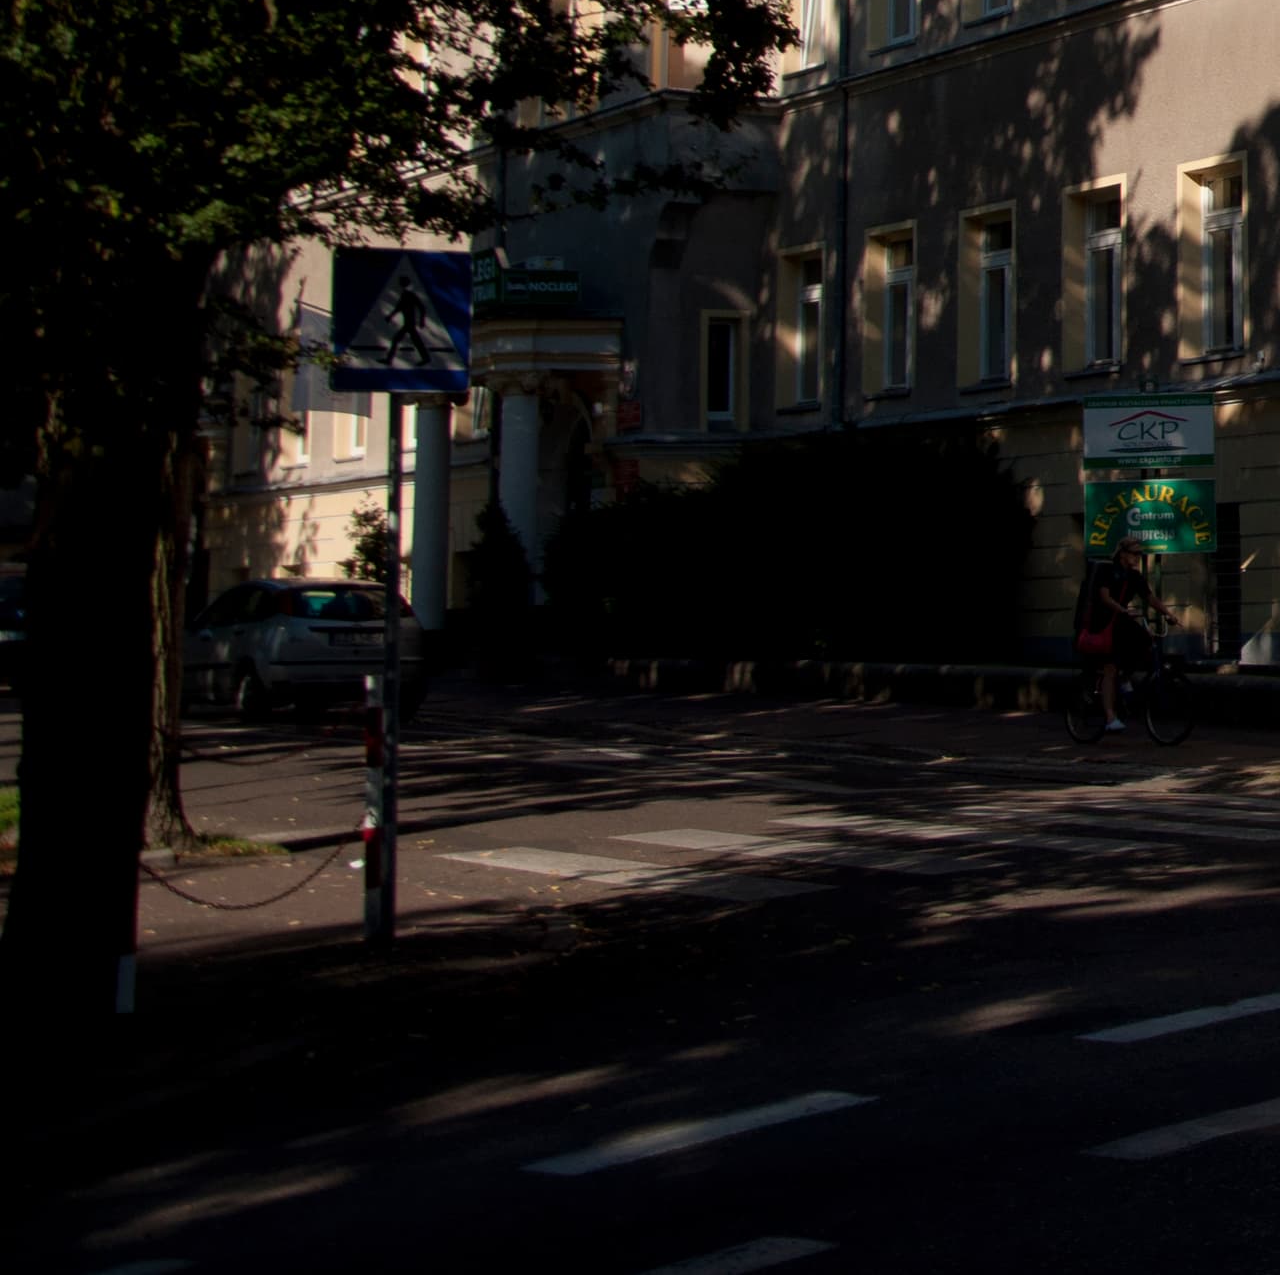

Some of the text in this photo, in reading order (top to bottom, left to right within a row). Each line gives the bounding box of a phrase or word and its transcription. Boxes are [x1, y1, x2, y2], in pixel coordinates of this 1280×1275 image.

[529, 281, 578, 293] NOCLEGI
[1118, 421, 1179, 442] CKP
[1089, 484, 1212, 547] RESTAURACJE
[1126, 507, 1175, 526] Centrum
